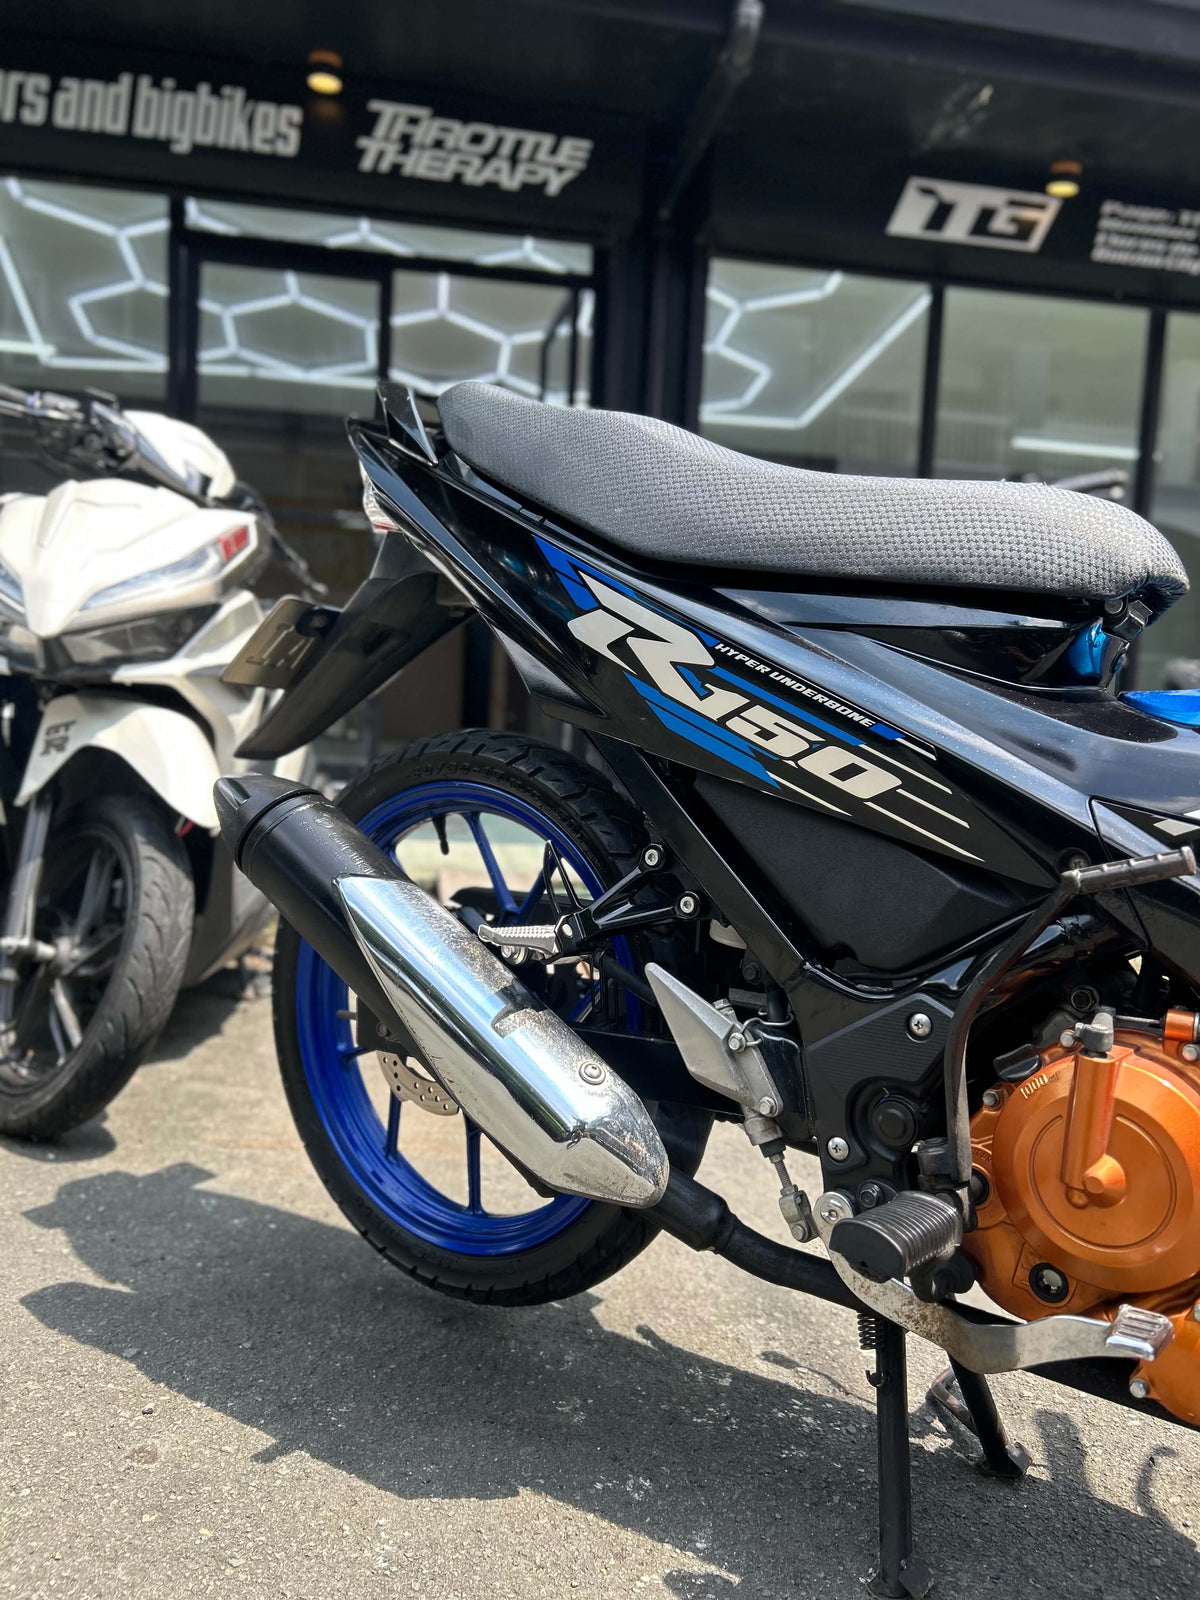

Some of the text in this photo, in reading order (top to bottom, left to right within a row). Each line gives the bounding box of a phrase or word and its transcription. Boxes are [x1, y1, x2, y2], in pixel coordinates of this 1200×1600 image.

[0, 68, 304, 157] rs and bigbikes
[356, 135, 581, 197] THERAPY
[714, 643, 877, 728] HYPER UNDERBONE
[1020, 1073, 1048, 1099] 1000
